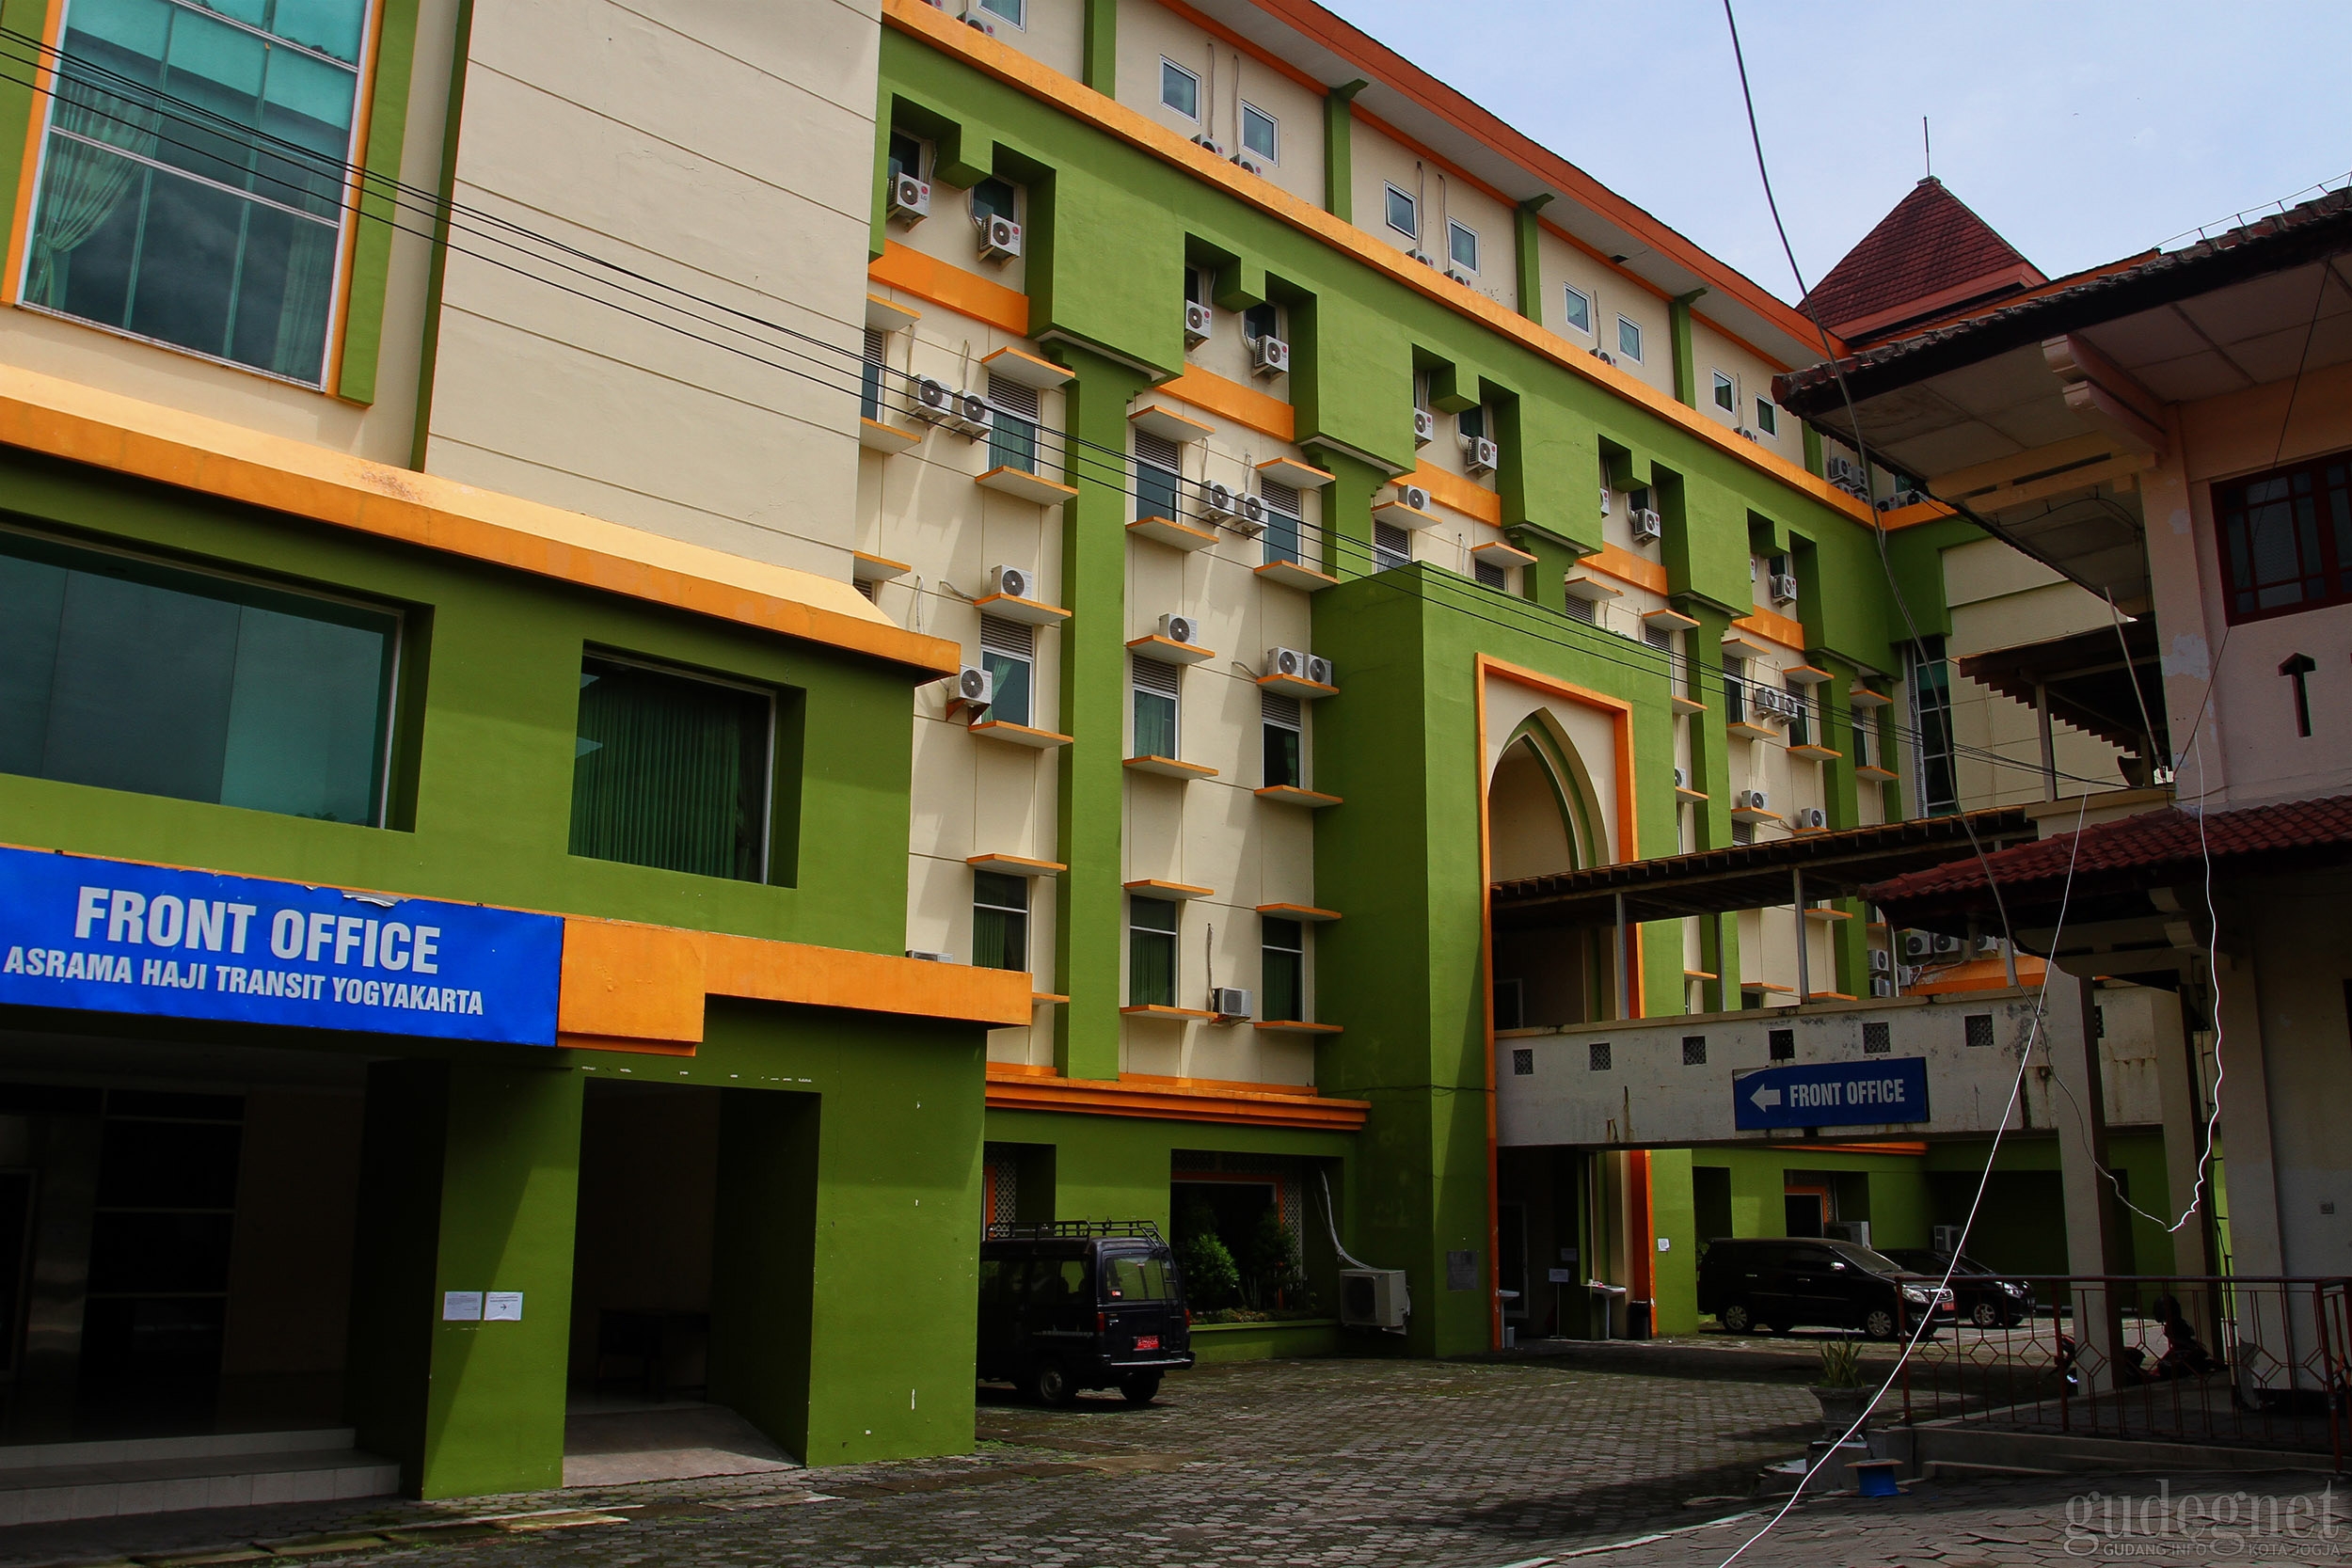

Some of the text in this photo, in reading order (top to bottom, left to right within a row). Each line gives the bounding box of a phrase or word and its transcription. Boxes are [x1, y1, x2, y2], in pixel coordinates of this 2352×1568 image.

[74, 886, 441, 974] FRONT OFFICE
[3, 945, 484, 1016] ASRAMA HAJI TRANSIT YOGYAKARTA
[1789, 1078, 1905, 1108] FRONT OFFICE
